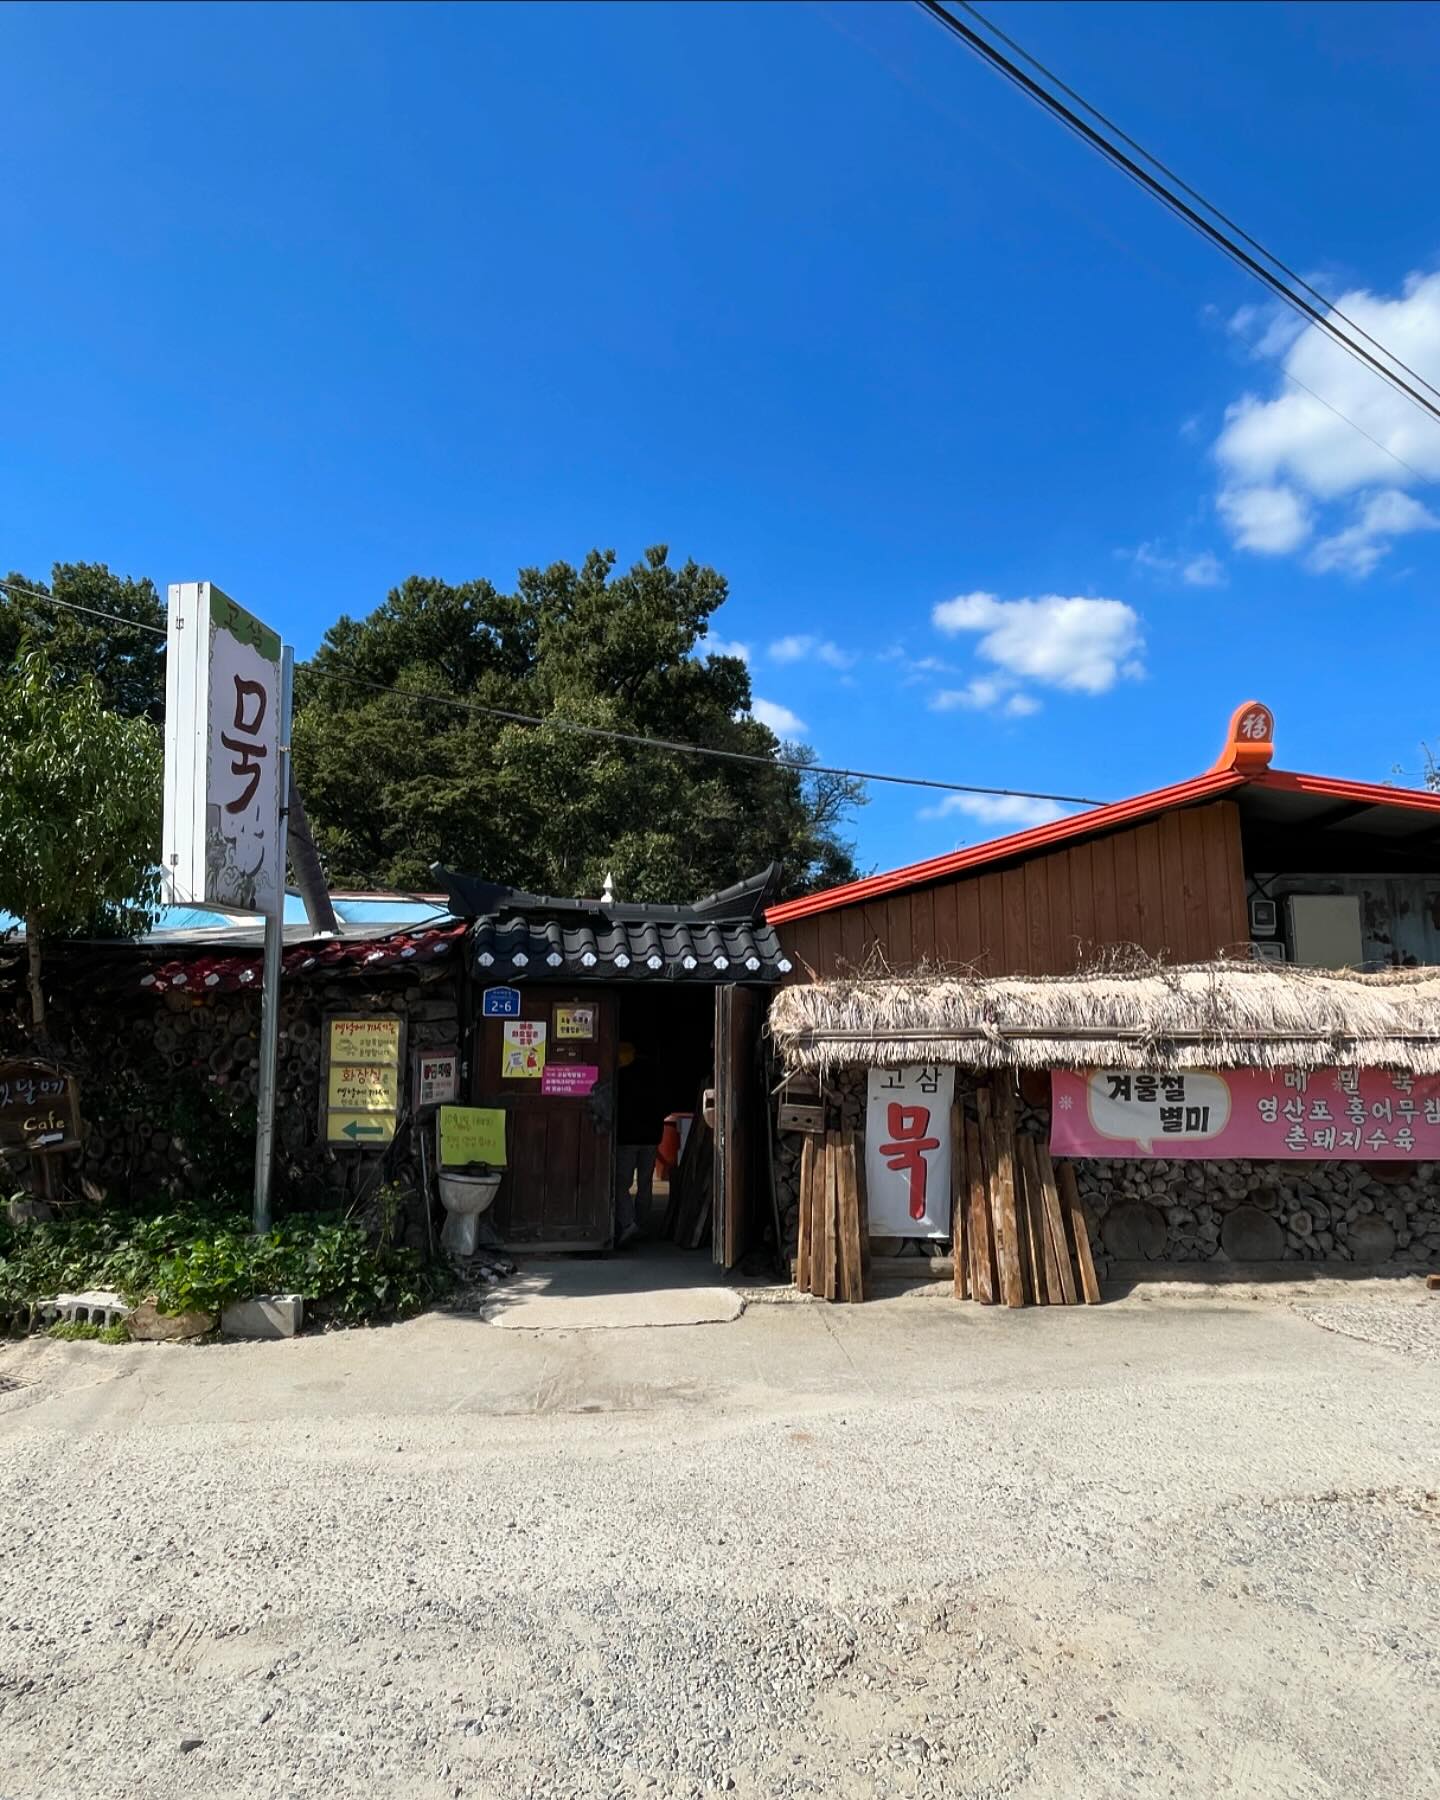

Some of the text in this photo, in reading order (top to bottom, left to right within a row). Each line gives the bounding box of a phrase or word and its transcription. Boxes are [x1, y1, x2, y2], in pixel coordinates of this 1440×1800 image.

[223, 602, 263, 648] 고삼
[220, 673, 268, 814] 묵
[491, 1000, 512, 1013] 2-6
[341, 1066, 380, 1084] 화장실
[880, 1067, 943, 1093] 고삼
[1106, 1075, 1185, 1103] 겨울철
[23, 1110, 65, 1131] Cafe
[1159, 1106, 1210, 1132] 별미
[1257, 1095, 1440, 1125] 영산포 홍어무침
[1284, 1124, 1416, 1152] 촌돼지수육
[878, 1102, 941, 1220] 묵
